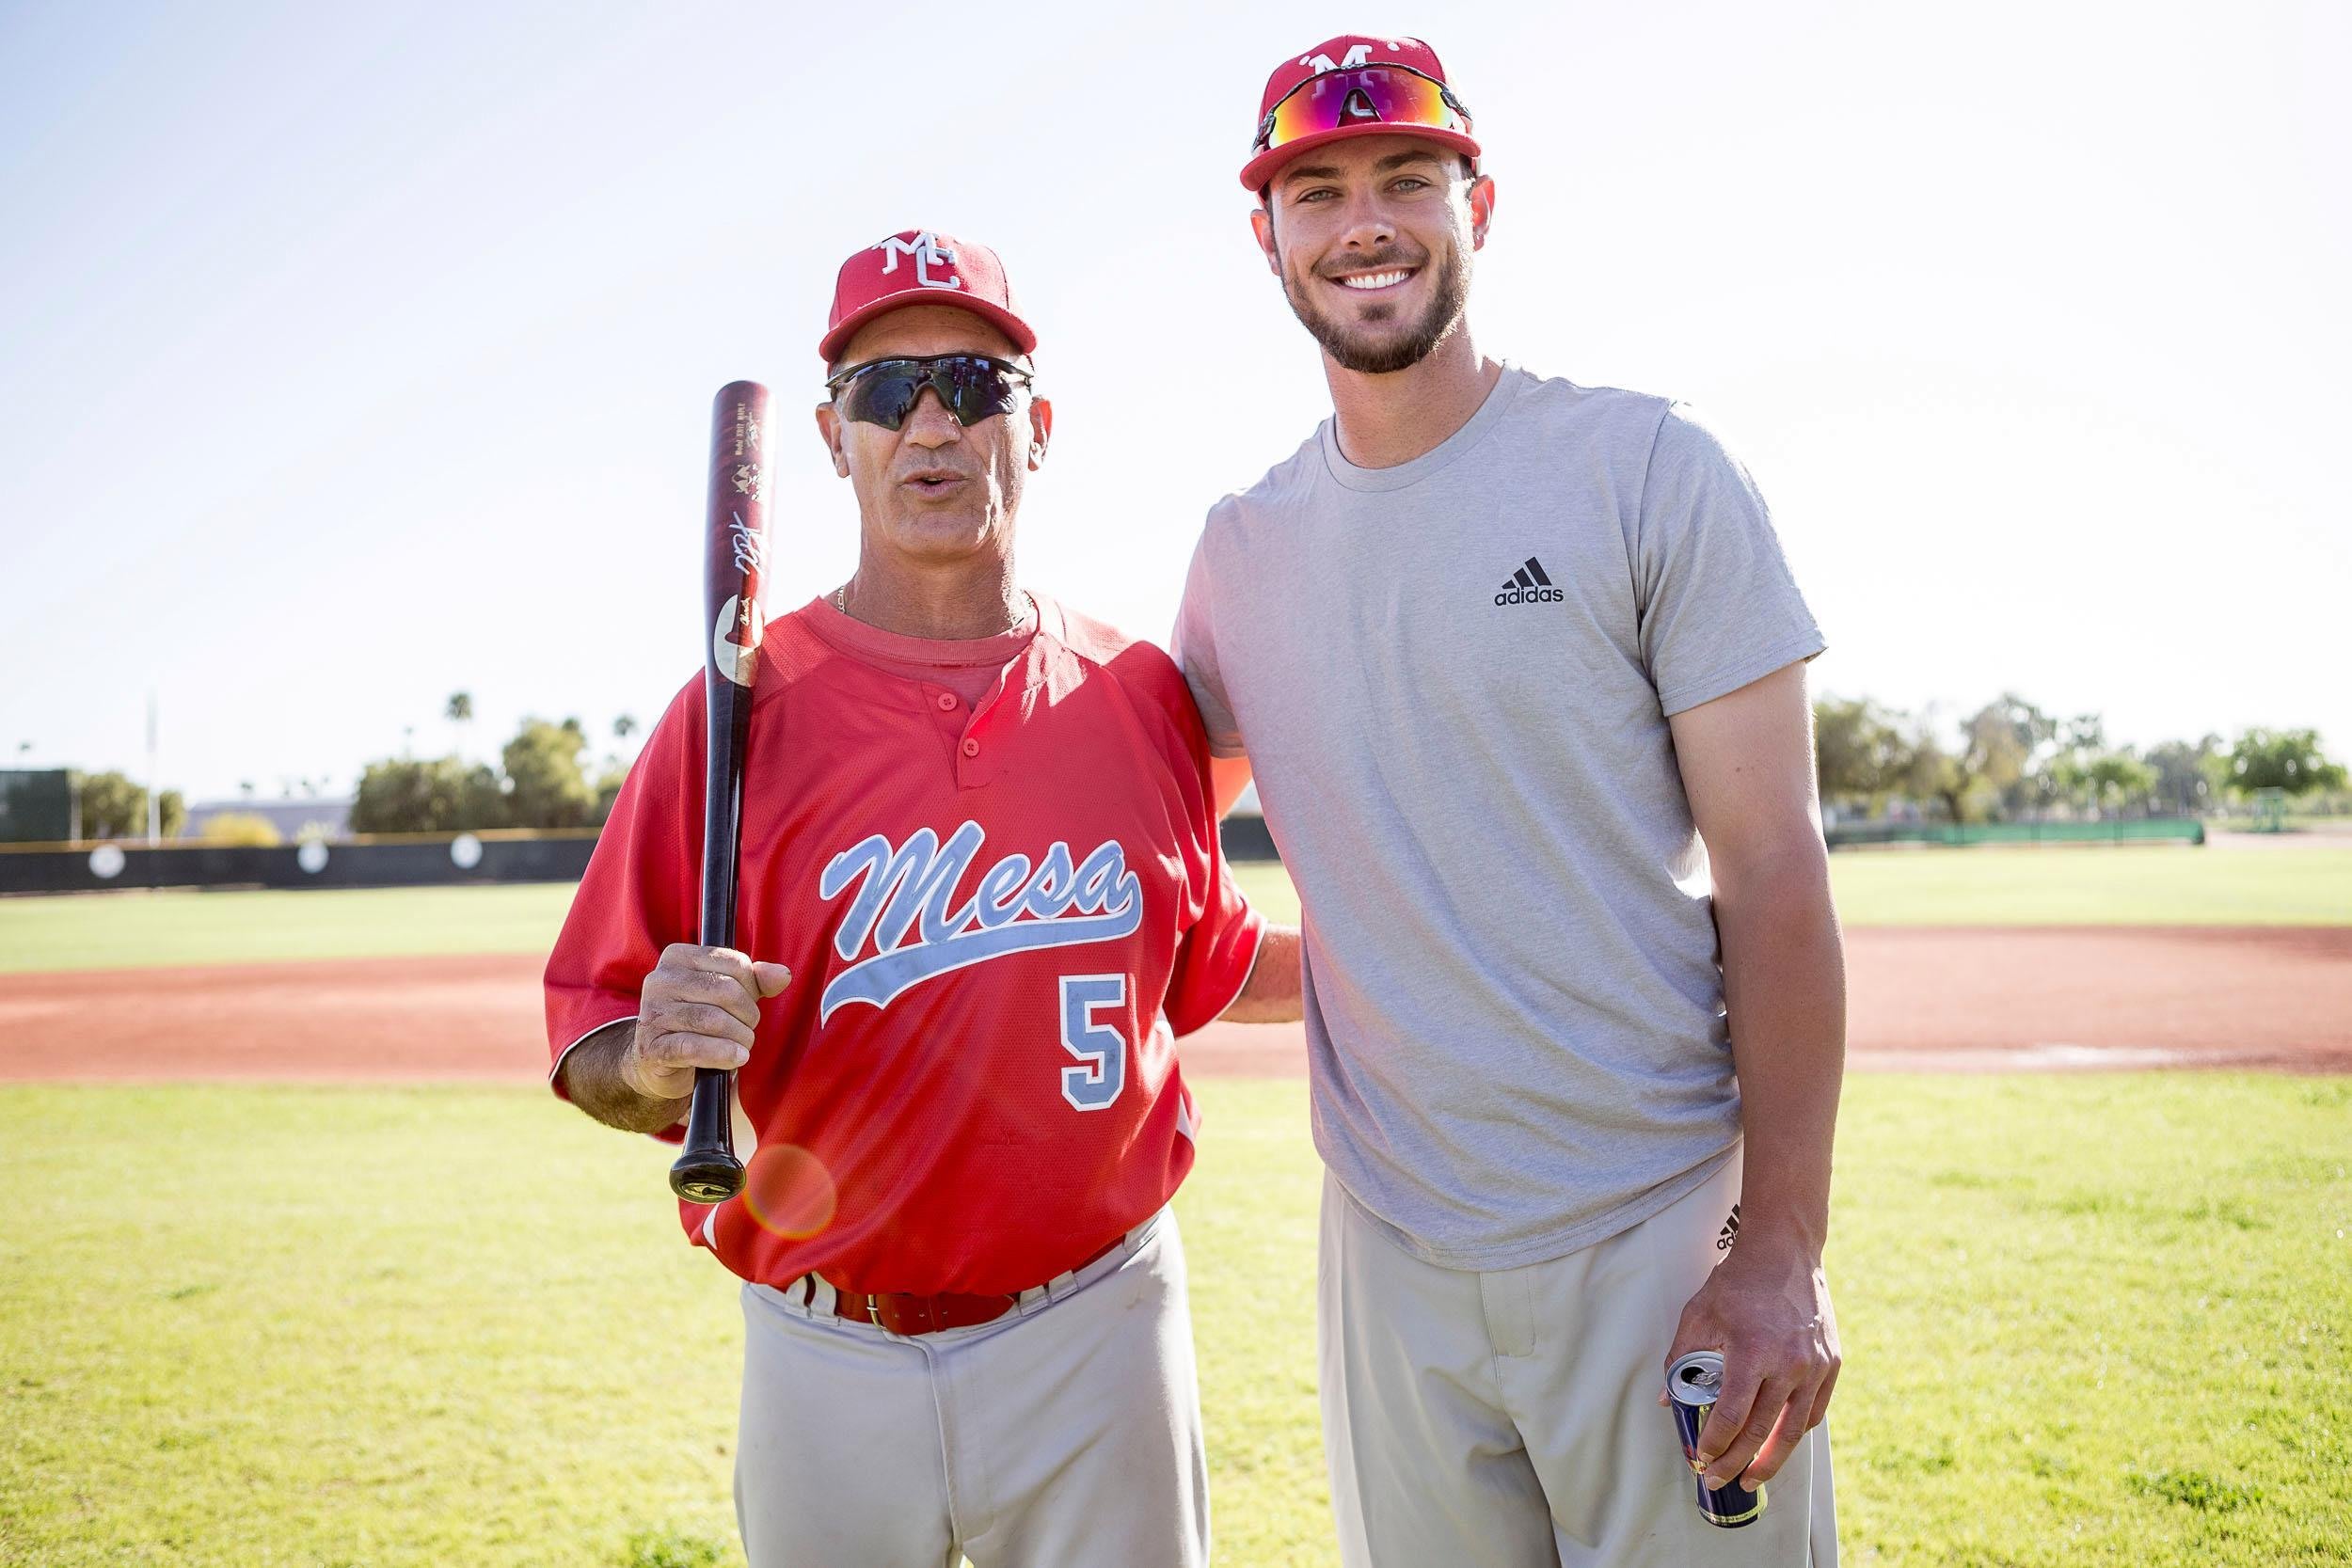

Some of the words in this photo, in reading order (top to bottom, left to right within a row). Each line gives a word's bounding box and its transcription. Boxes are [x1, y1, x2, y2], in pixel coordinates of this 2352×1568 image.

[1494, 585, 1565, 607] adidas
[819, 819, 1143, 963] Mesa
[1058, 973, 1127, 1112] 5
